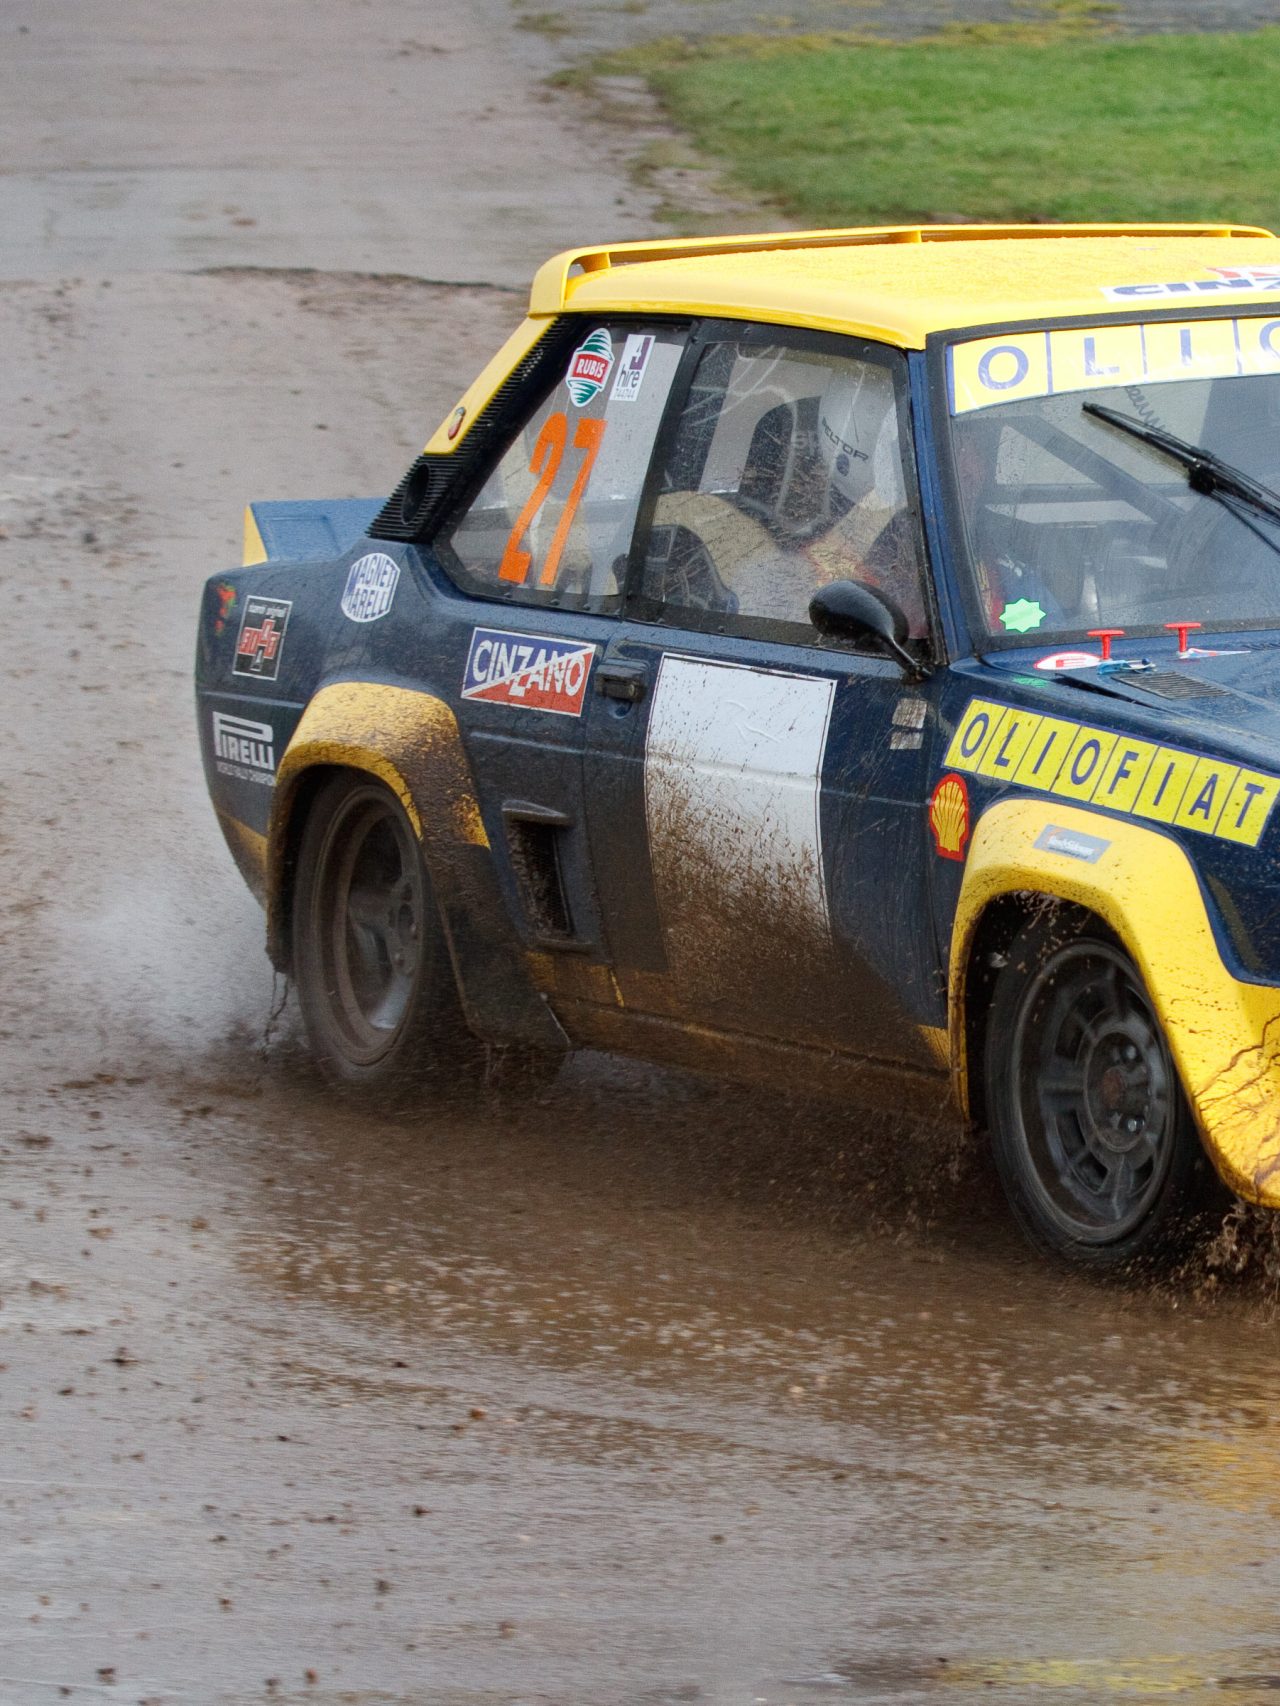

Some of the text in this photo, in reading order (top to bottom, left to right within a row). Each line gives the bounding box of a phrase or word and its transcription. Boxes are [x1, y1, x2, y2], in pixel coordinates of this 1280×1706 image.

[576, 358, 606, 378] RUBIS
[617, 364, 640, 388] hire
[499, 412, 608, 584] 27
[347, 555, 399, 590] MAGNETI
[343, 588, 396, 619] MARELLI
[473, 640, 586, 697] CINZANO
[212, 711, 275, 771] PIRELLI
